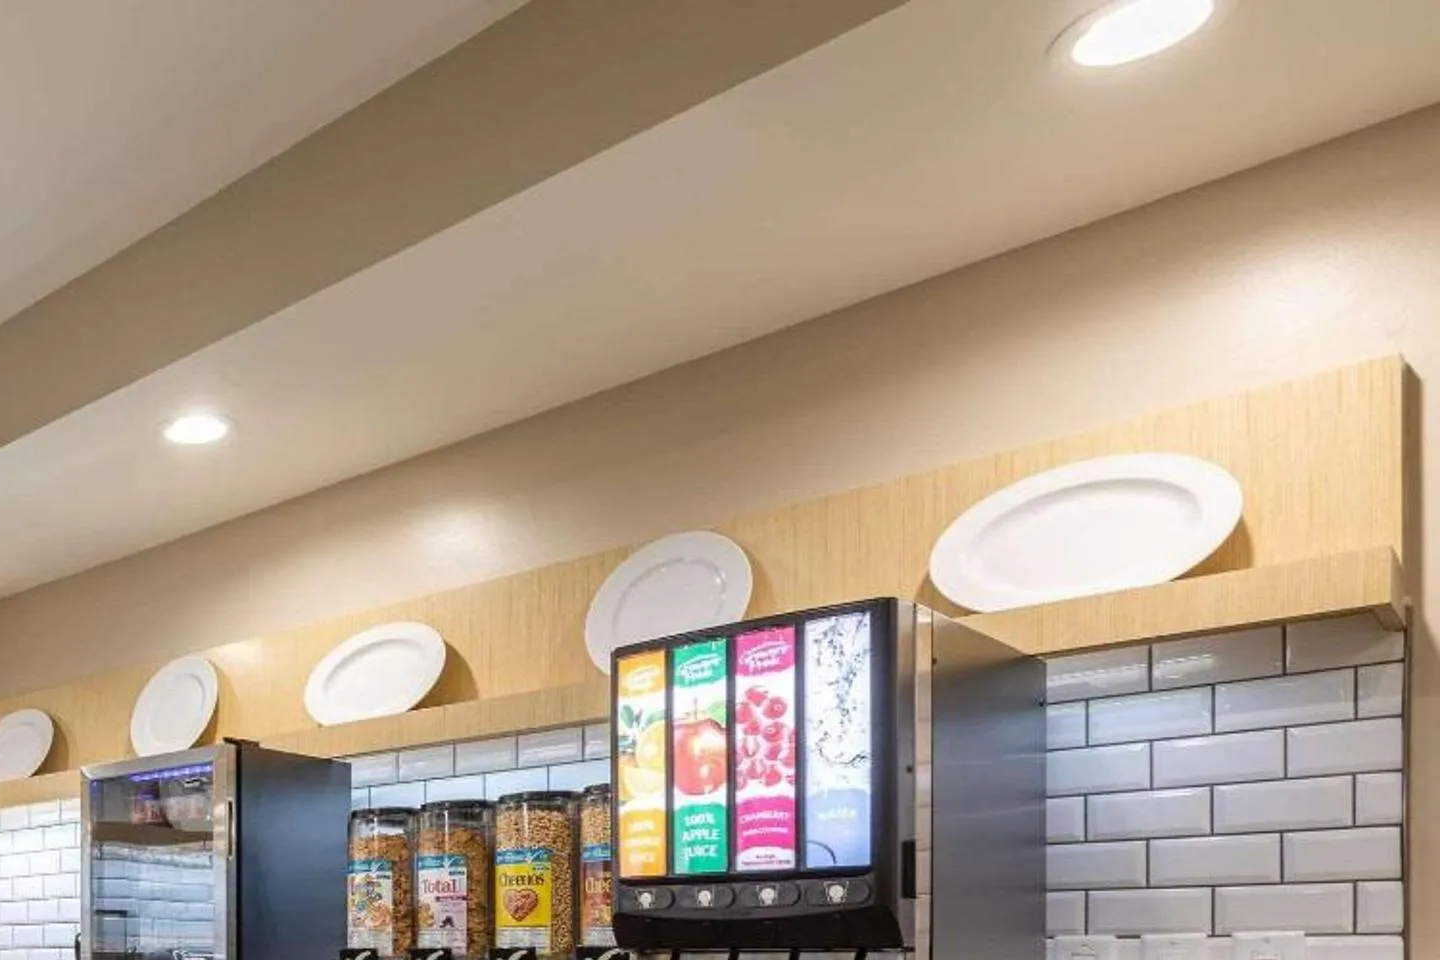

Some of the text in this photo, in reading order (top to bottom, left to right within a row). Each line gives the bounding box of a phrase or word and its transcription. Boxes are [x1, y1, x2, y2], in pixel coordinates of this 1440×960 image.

[682, 829, 721, 841] APPLE
[684, 844, 719, 861] JUICE
[422, 878, 456, 893] Total
[501, 873, 544, 887] Cheerios
